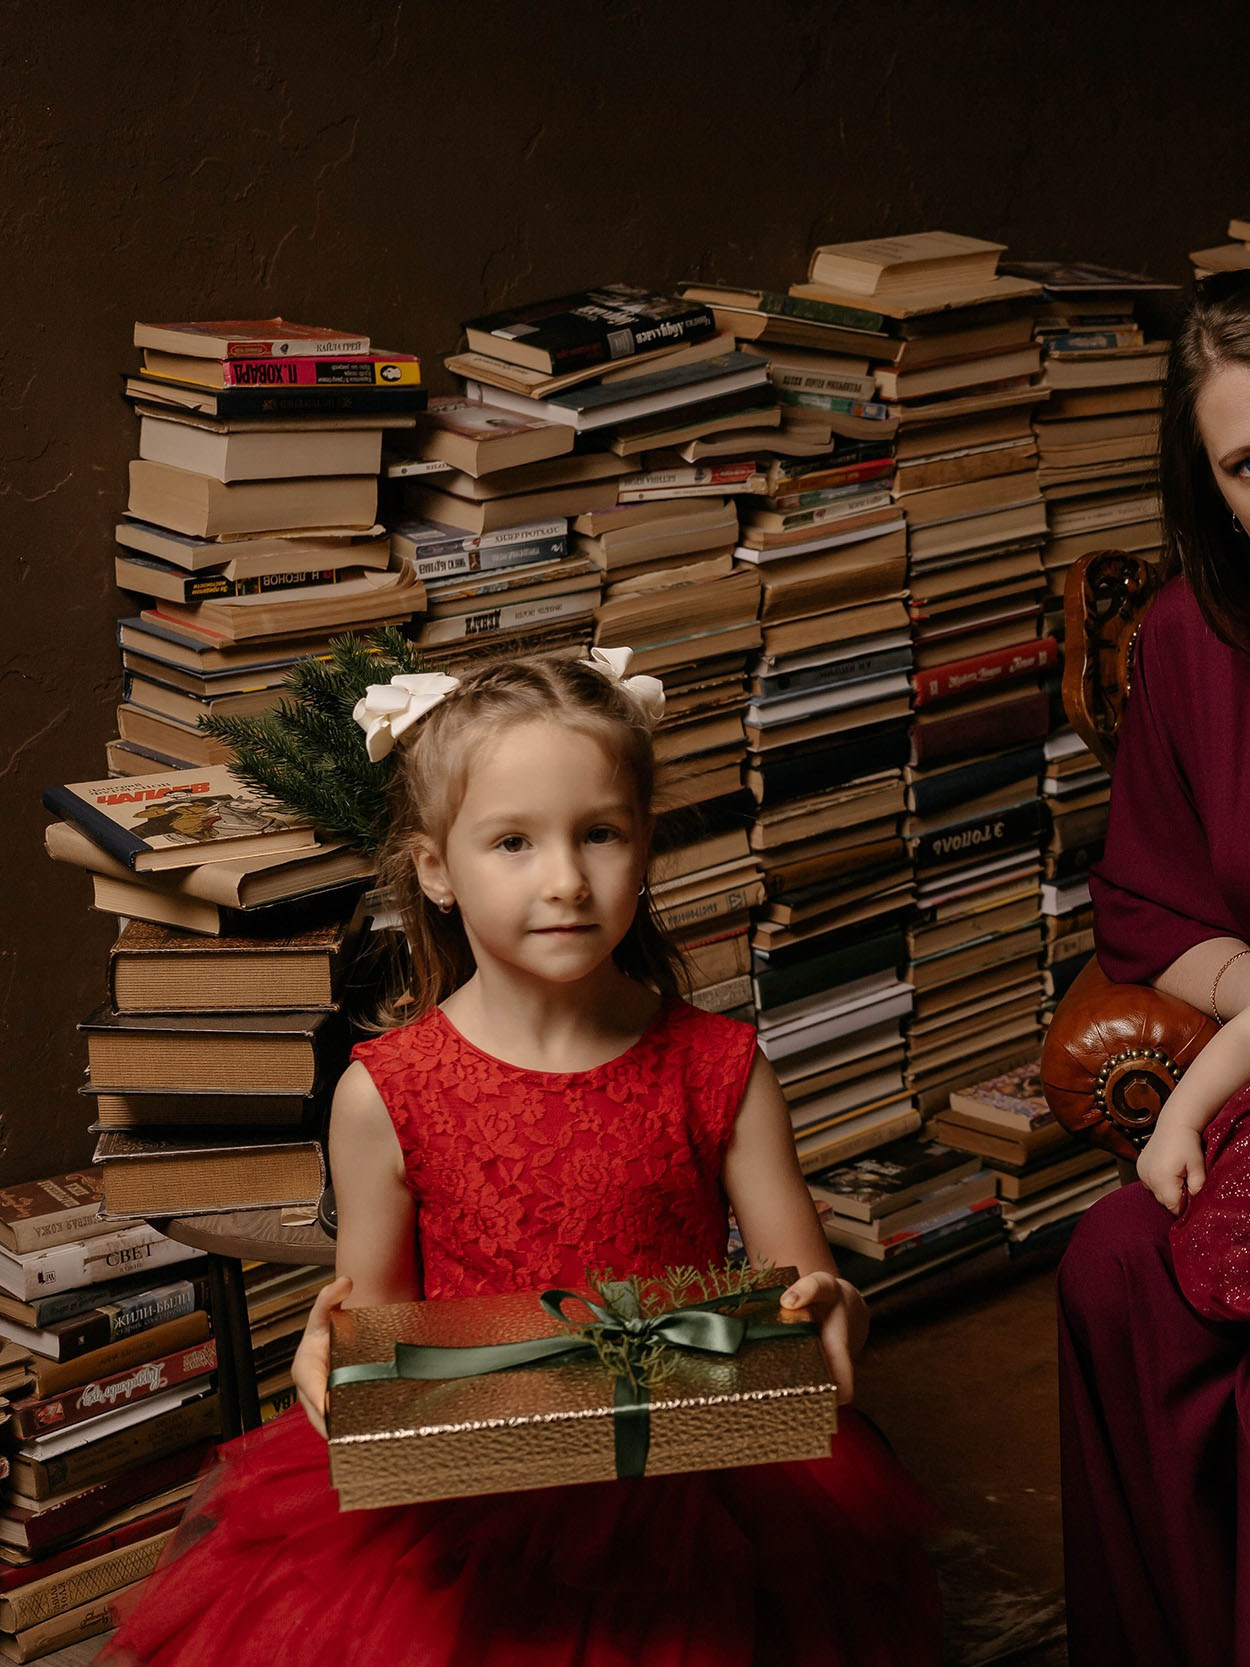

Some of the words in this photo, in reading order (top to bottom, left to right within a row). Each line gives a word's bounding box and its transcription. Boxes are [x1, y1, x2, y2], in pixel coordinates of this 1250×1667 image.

[316, 342, 342, 353] КАЙЛА
[342, 341, 362, 352] ГРЕЙ
[465, 610, 501, 634] ДЕНЬГИ
[97, 782, 210, 805] ЧАПАЕВ
[931, 824, 991, 855] ТОПОЛЬ
[105, 1243, 154, 1268] СВЕТ
[113, 1291, 192, 1330] ЖИЛИ-БЫЛИ
